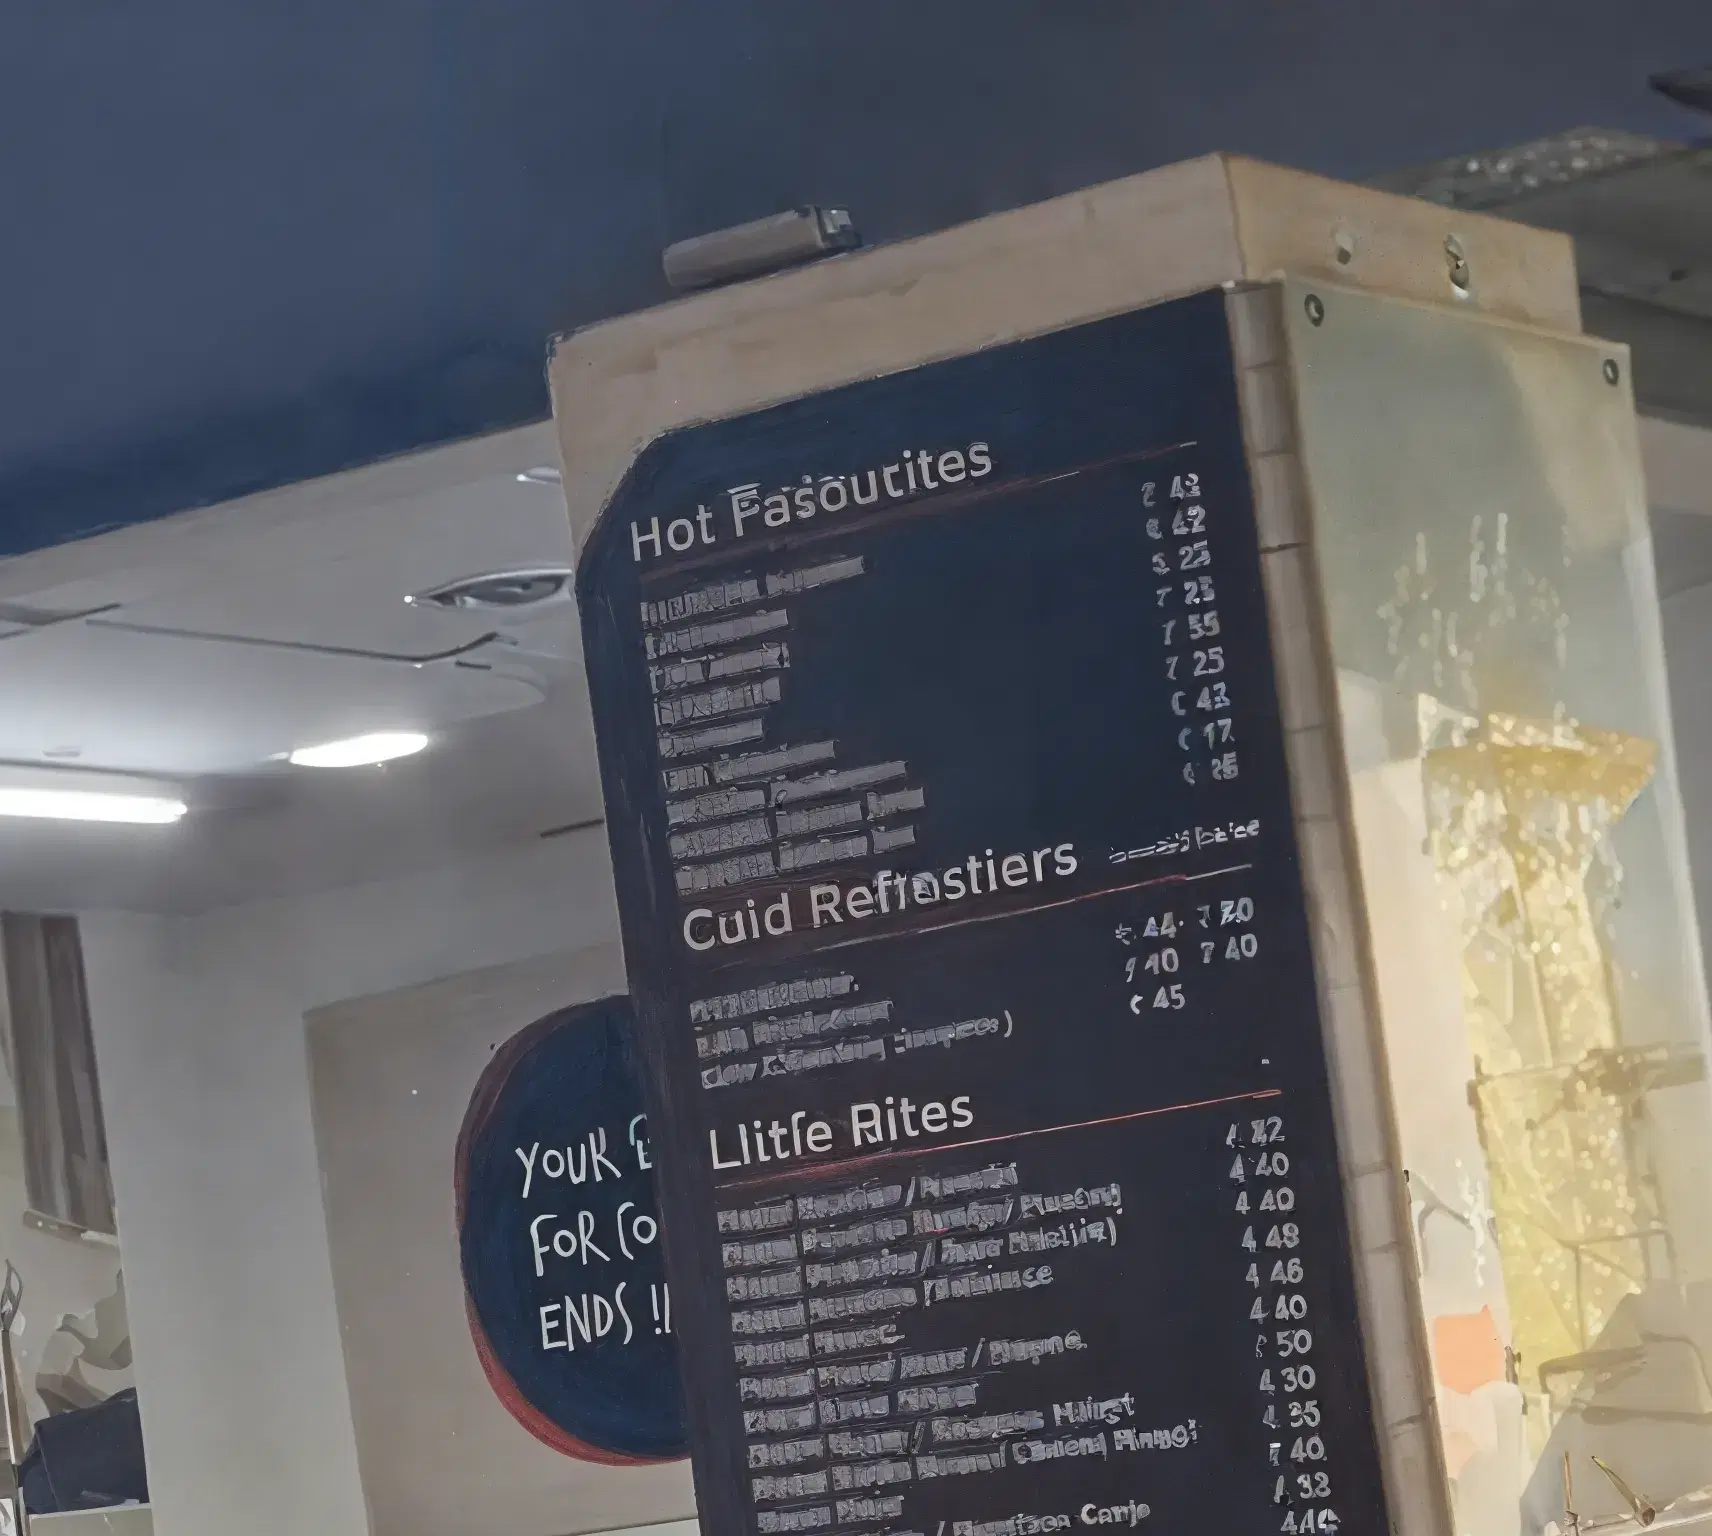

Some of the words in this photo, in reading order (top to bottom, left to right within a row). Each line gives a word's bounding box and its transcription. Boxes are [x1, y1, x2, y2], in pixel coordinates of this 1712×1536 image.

[630, 503, 717, 563] Hot
[683, 890, 793, 951] Cuid
[530, 1210, 611, 1277] FOR
[539, 1281, 633, 1352] ENDS
[1276, 1328, 1313, 1357] 50
